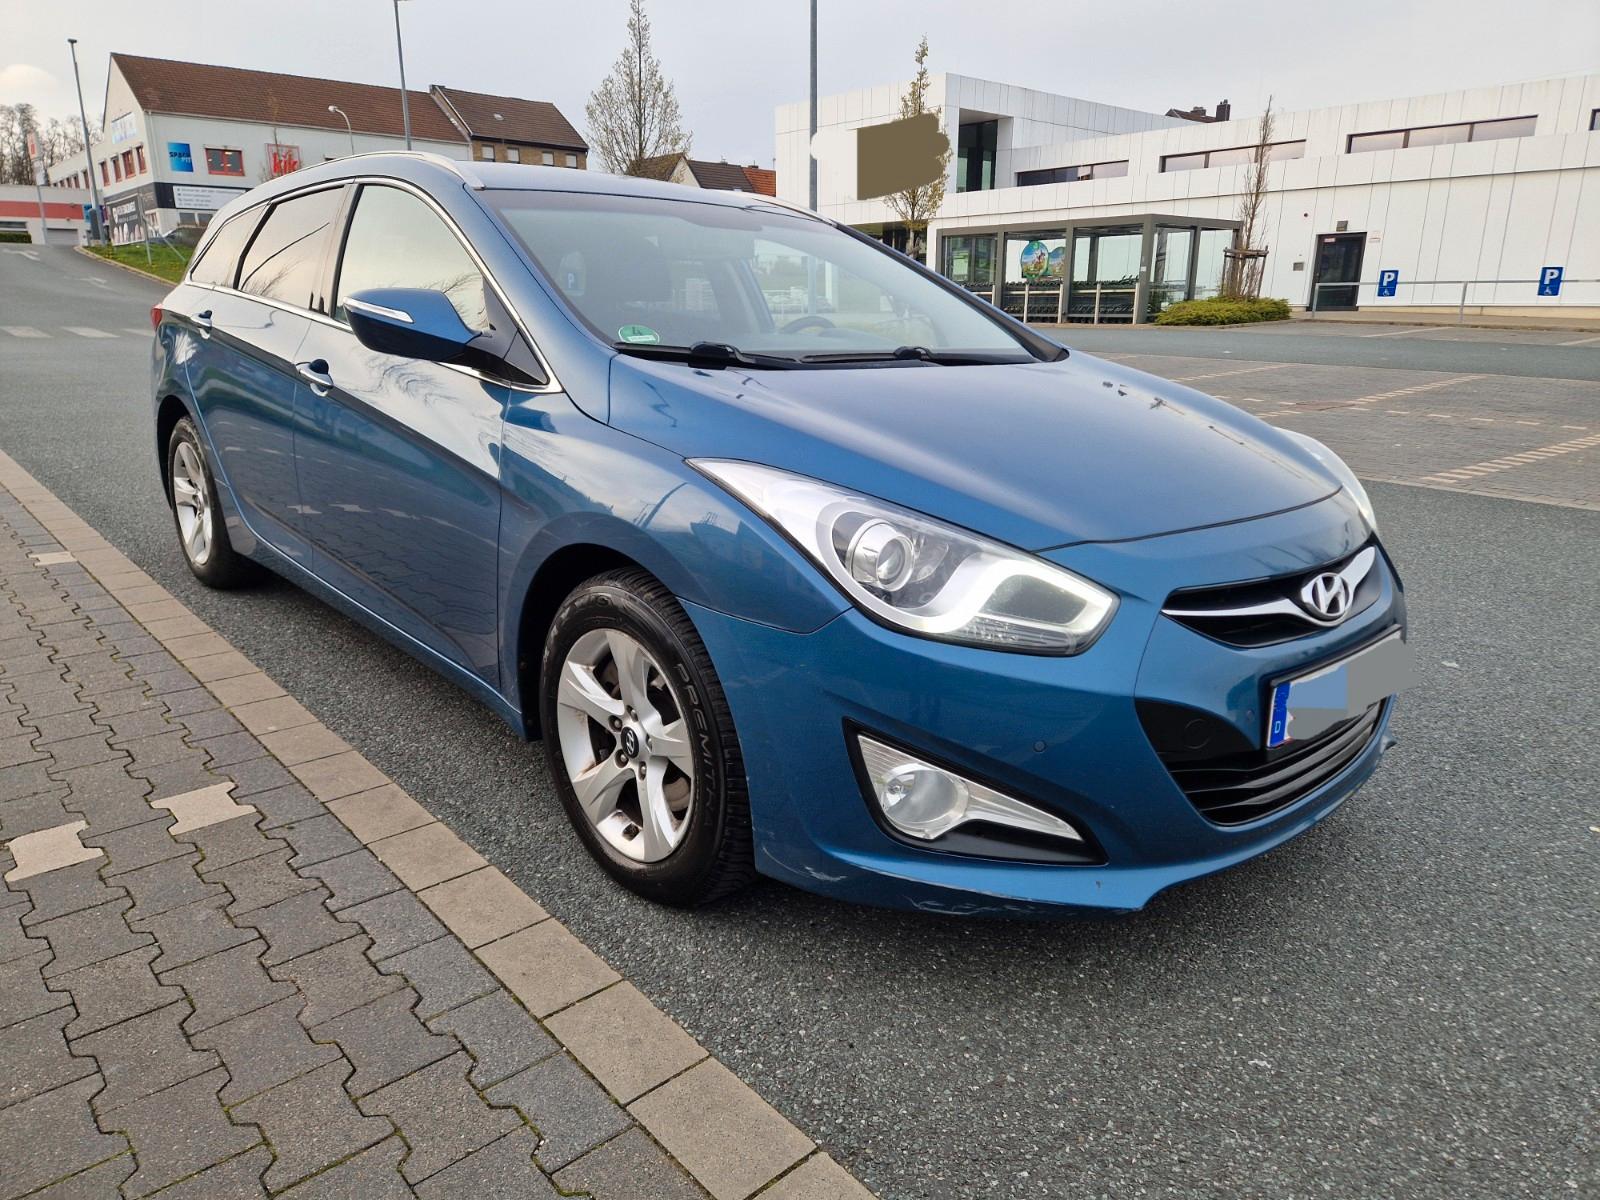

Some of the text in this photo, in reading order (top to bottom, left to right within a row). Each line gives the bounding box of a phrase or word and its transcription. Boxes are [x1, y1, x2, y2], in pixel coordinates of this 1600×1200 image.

[1382, 272, 1395, 286] P
[1544, 269, 1559, 284] P
[1274, 720, 1281, 734] D
